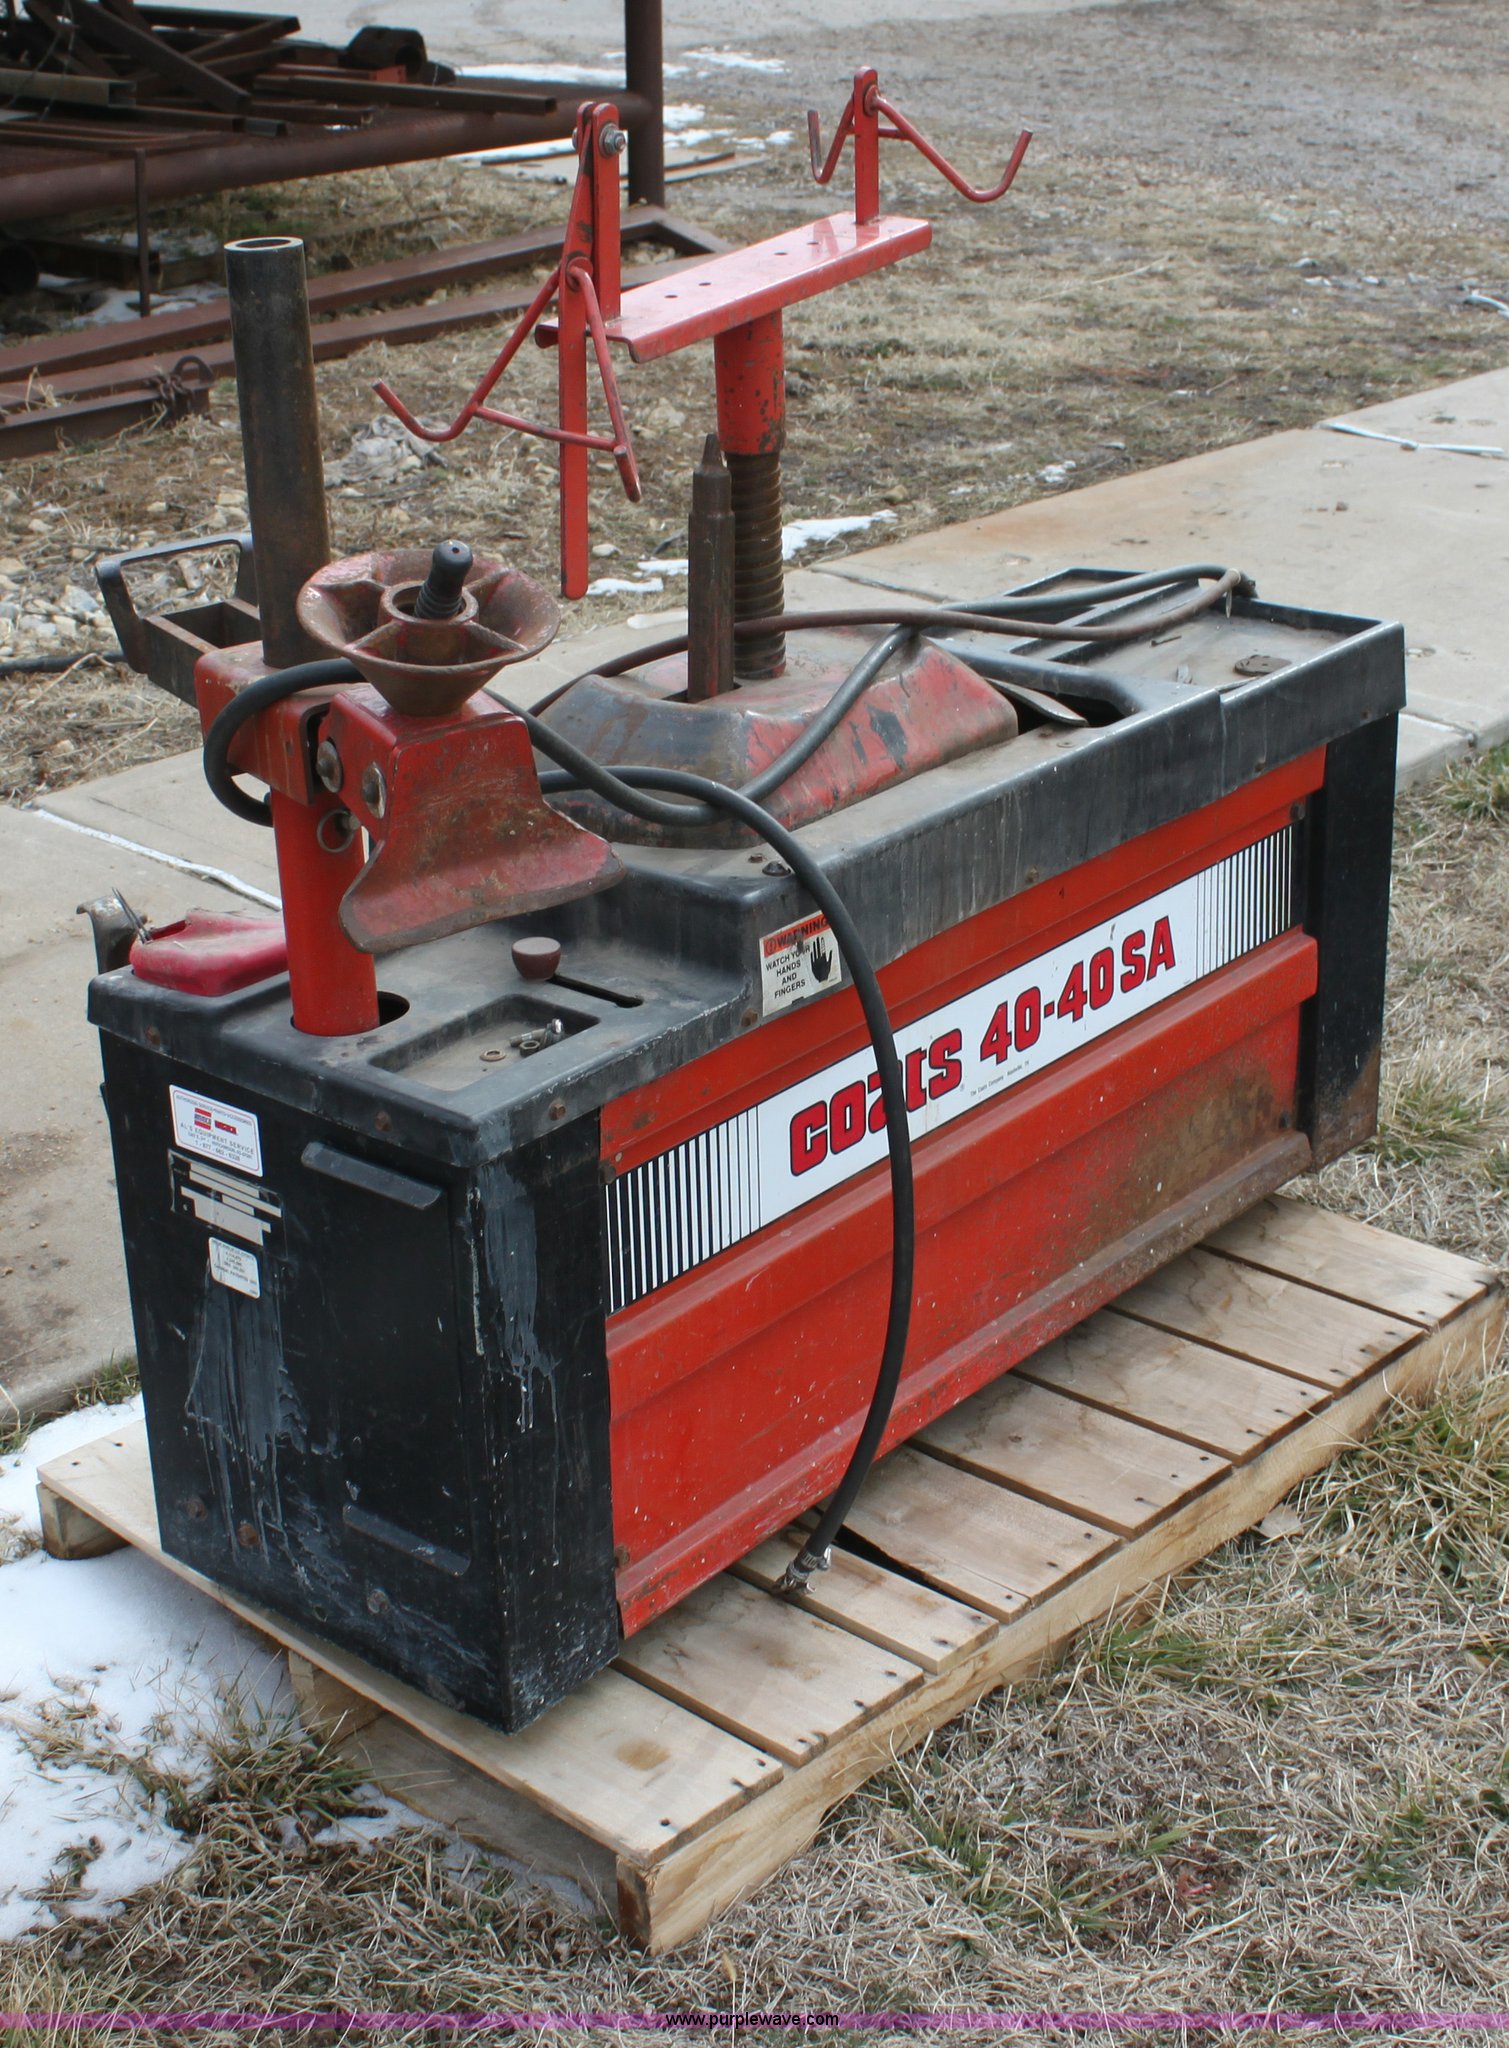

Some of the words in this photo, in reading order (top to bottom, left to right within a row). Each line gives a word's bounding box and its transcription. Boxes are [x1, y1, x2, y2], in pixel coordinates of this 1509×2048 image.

[766, 955, 789, 971] WATCH
[776, 960, 801, 977] HANDS
[782, 972, 797, 985] AND
[774, 979, 806, 999] FINGERS
[229, 1139, 254, 1155] SERVICE
